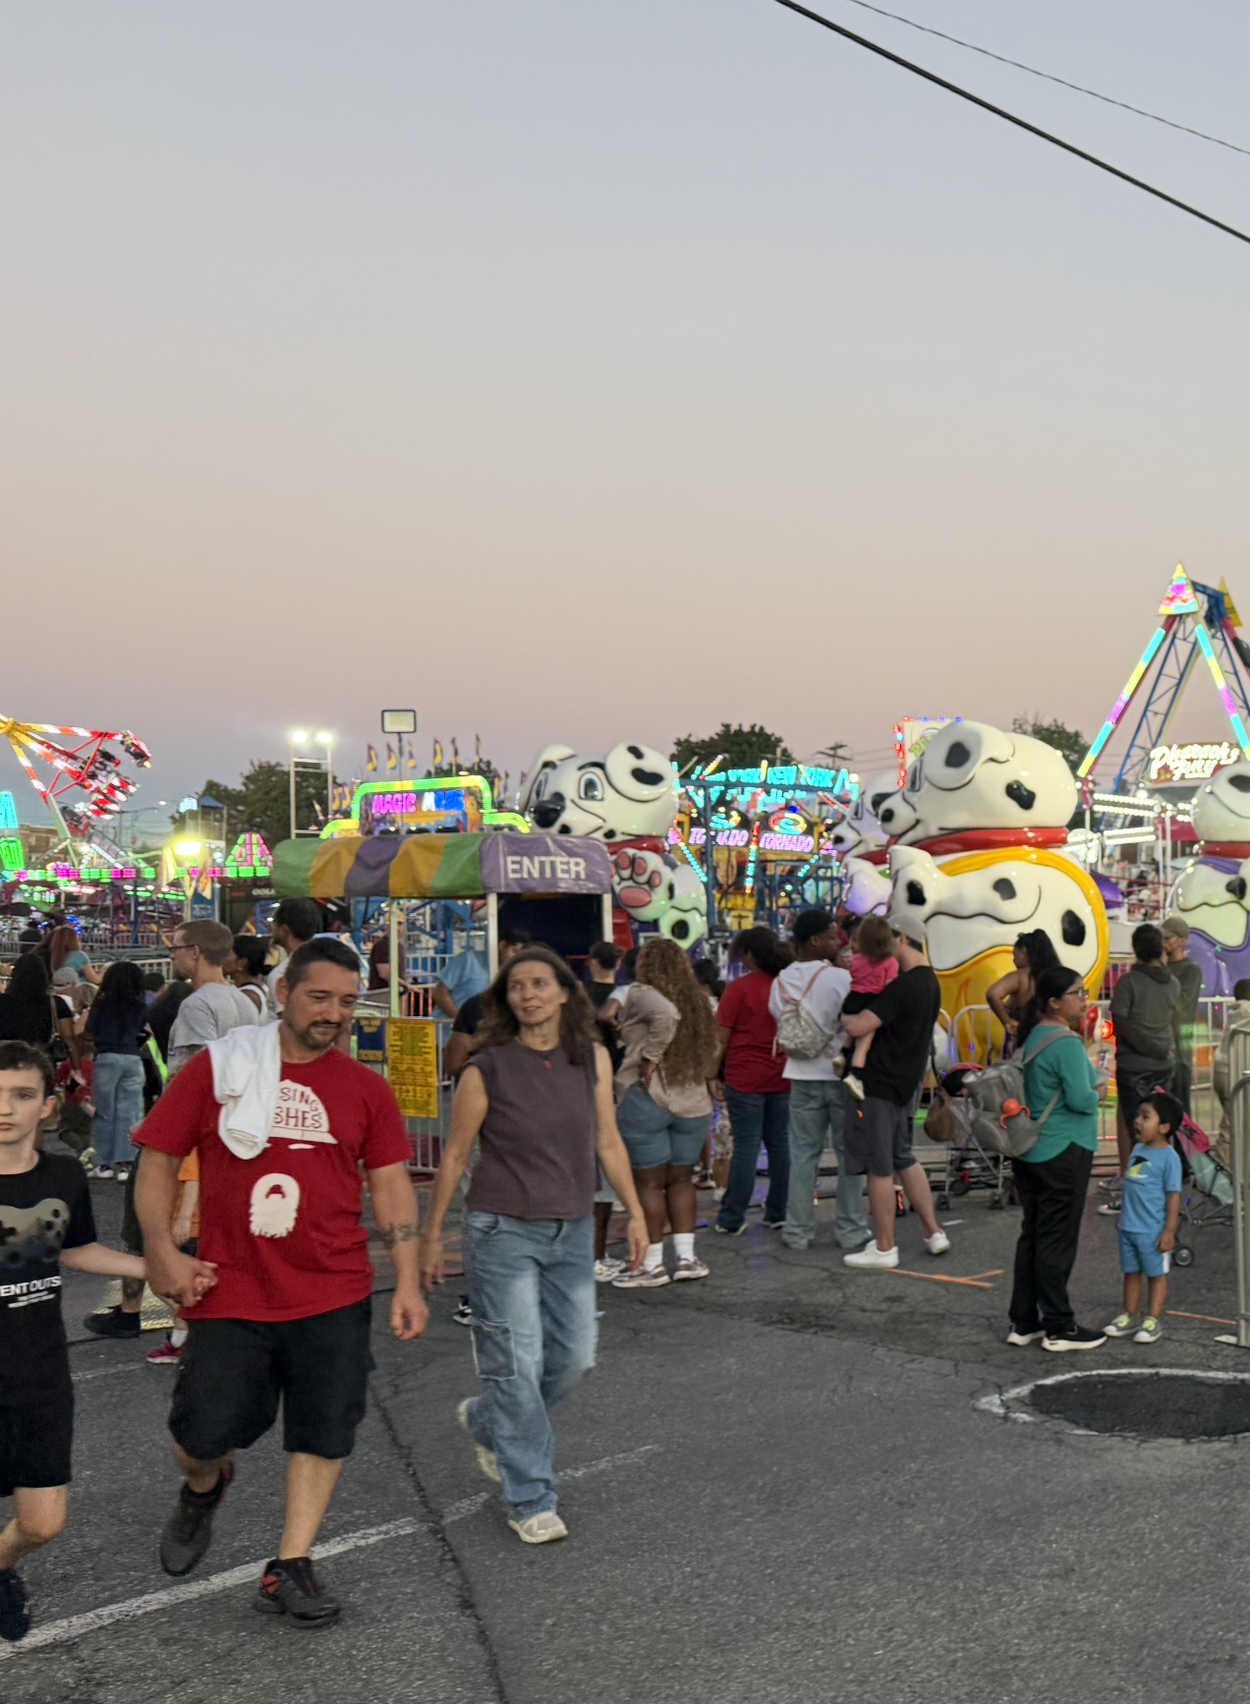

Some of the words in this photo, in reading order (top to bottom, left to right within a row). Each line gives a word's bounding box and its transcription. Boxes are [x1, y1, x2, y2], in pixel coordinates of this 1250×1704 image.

[1169, 759, 1218, 781] Fury
[372, 793, 417, 814] MAGIC
[759, 832, 815, 852] TORNADO
[506, 855, 586, 879] ENTER
